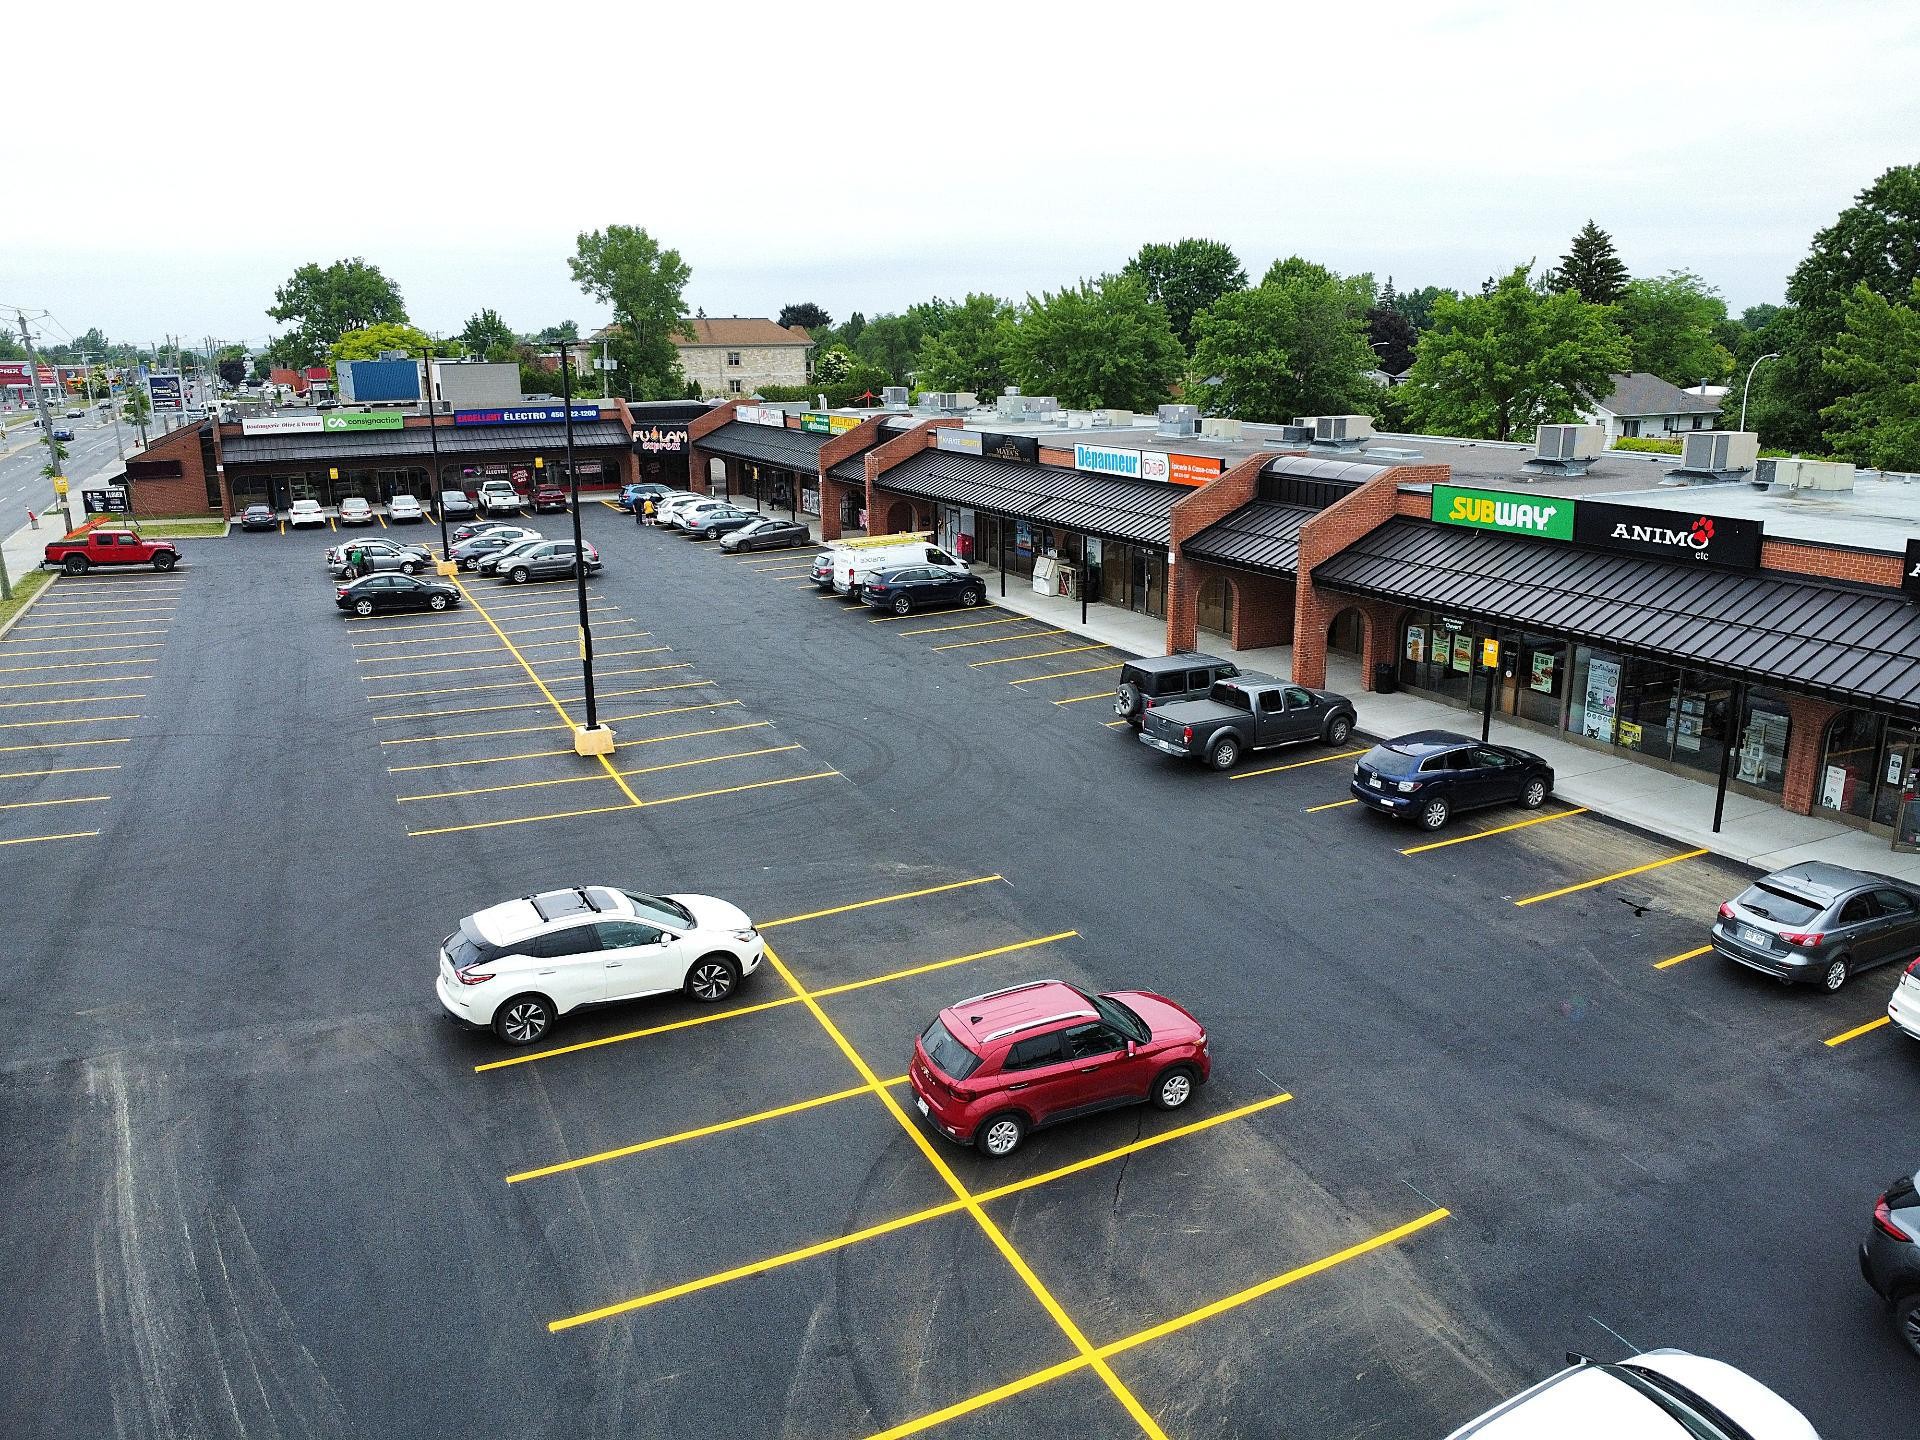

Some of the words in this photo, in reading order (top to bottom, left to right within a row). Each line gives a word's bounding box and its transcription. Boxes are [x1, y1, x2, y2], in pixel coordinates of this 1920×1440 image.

[347, 416, 400, 426] consignaction
[504, 411, 547, 420] ÉLECTRO
[632, 430, 650, 442] FU
[659, 430, 688, 443] LAM
[1077, 446, 1138, 474] Dépanneur
[1449, 496, 1557, 531] SUBWAY
[1611, 523, 1709, 550] ANIMO
[1695, 550, 1709, 560] etc
